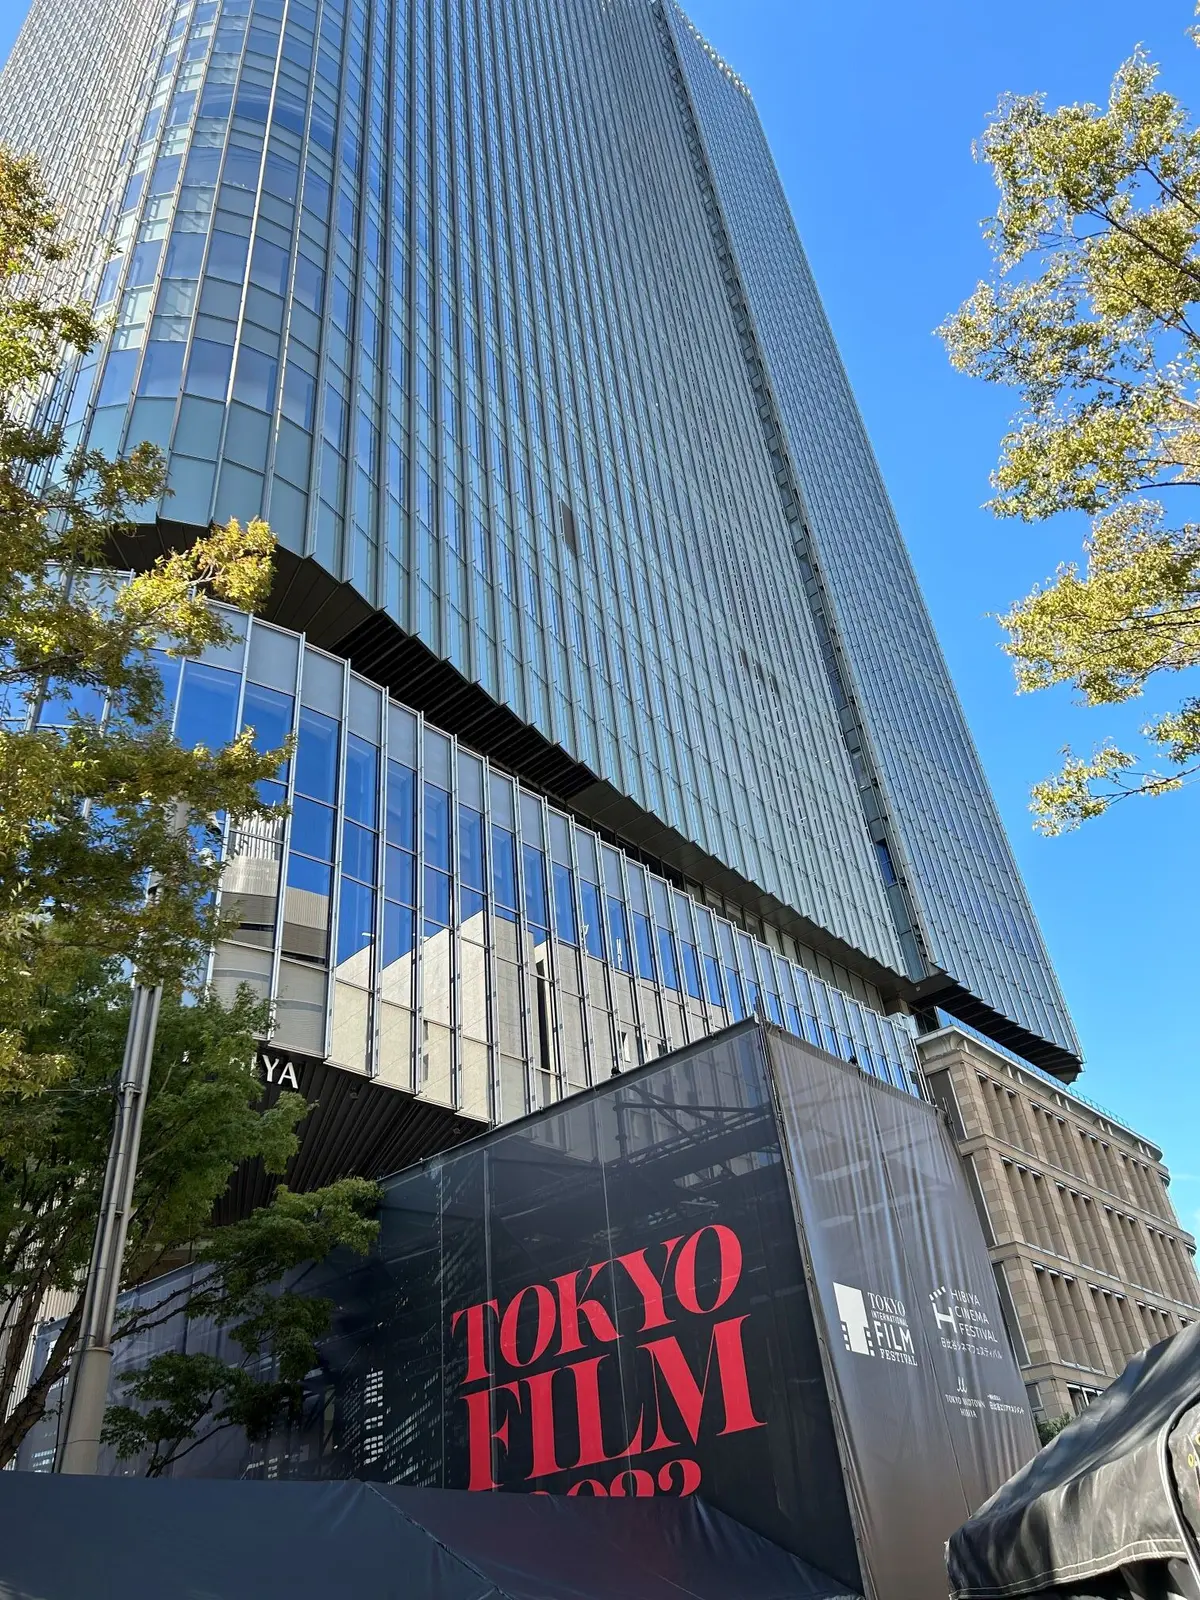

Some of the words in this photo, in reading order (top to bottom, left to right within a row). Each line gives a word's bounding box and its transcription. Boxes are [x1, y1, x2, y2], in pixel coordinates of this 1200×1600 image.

[451, 1224, 743, 1384] TOKYO
[867, 1291, 906, 1317] TOKYO
[949, 1288, 981, 1307] HIBIYA
[870, 1309, 909, 1327] INTERNATIONAL
[954, 1305, 990, 1325] CINEMA
[873, 1320, 915, 1354] FILM
[958, 1322, 998, 1343] FESTIVAL
[879, 1348, 918, 1367] FESTIVAL
[459, 1313, 768, 1492] FILM
